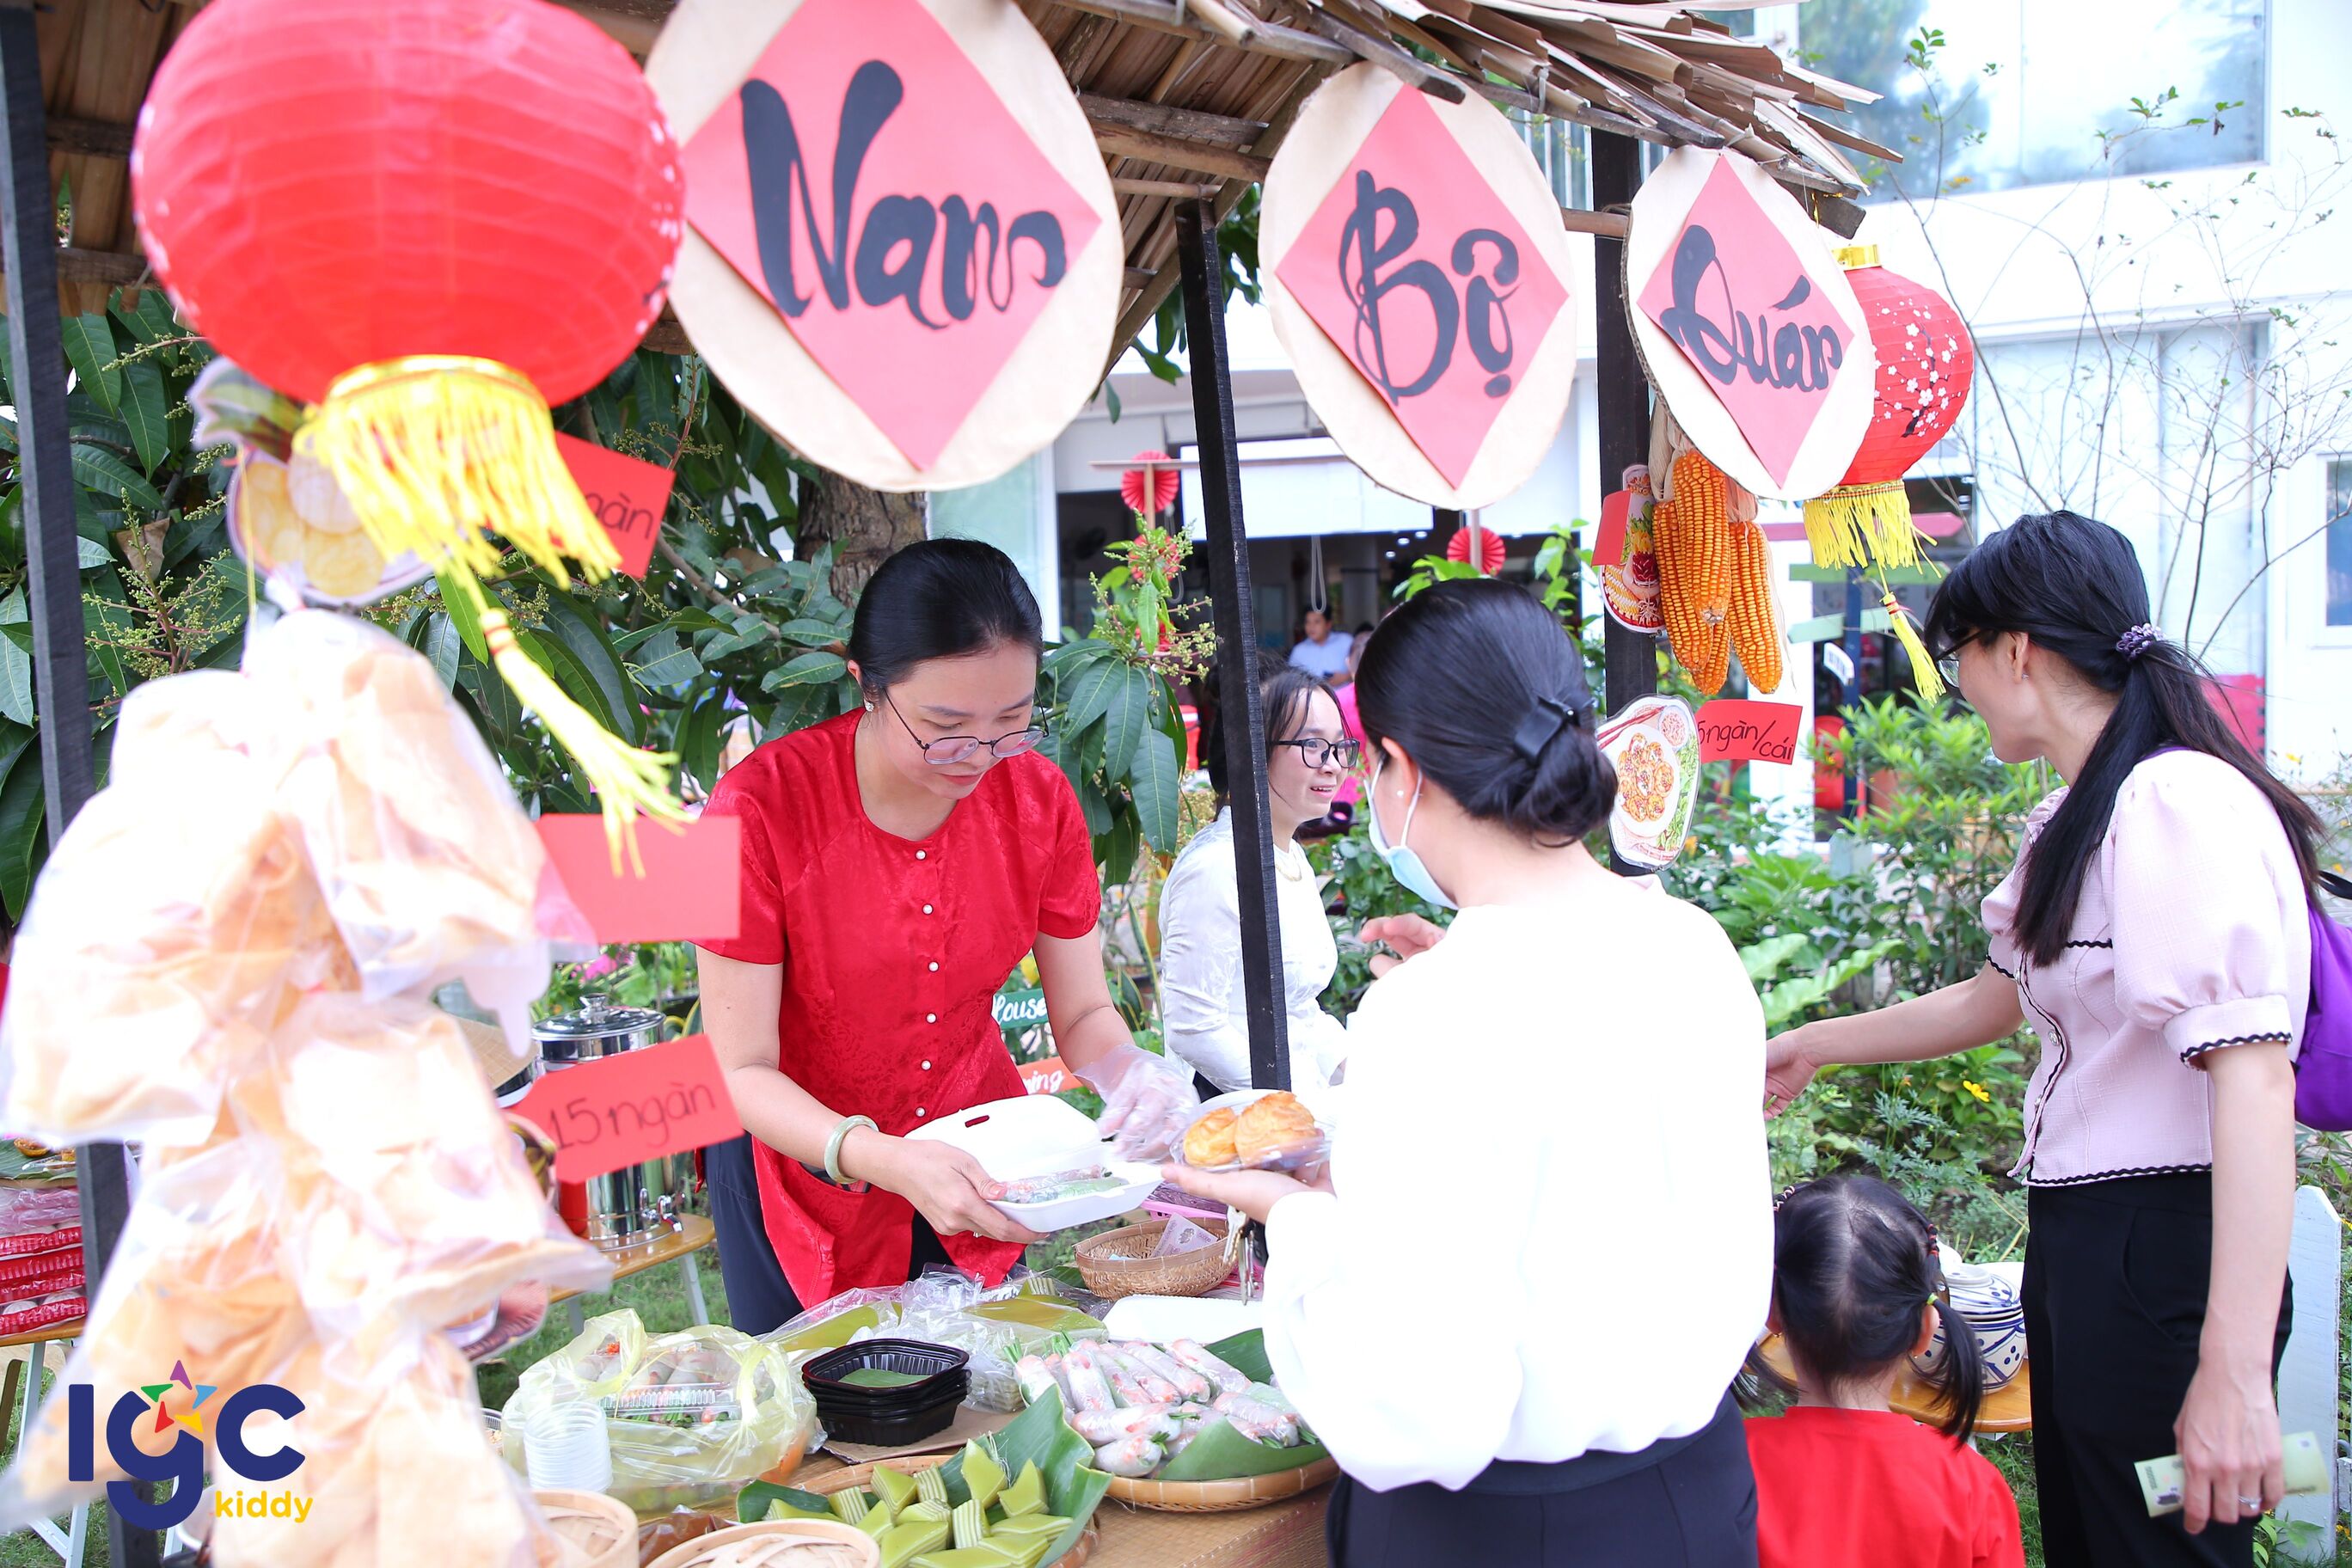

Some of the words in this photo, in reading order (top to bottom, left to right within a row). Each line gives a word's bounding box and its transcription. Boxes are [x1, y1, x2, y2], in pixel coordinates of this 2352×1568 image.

[740, 59, 1068, 330] Nam
[1338, 169, 1522, 406] Bộ
[1659, 224, 1843, 393] Quán
